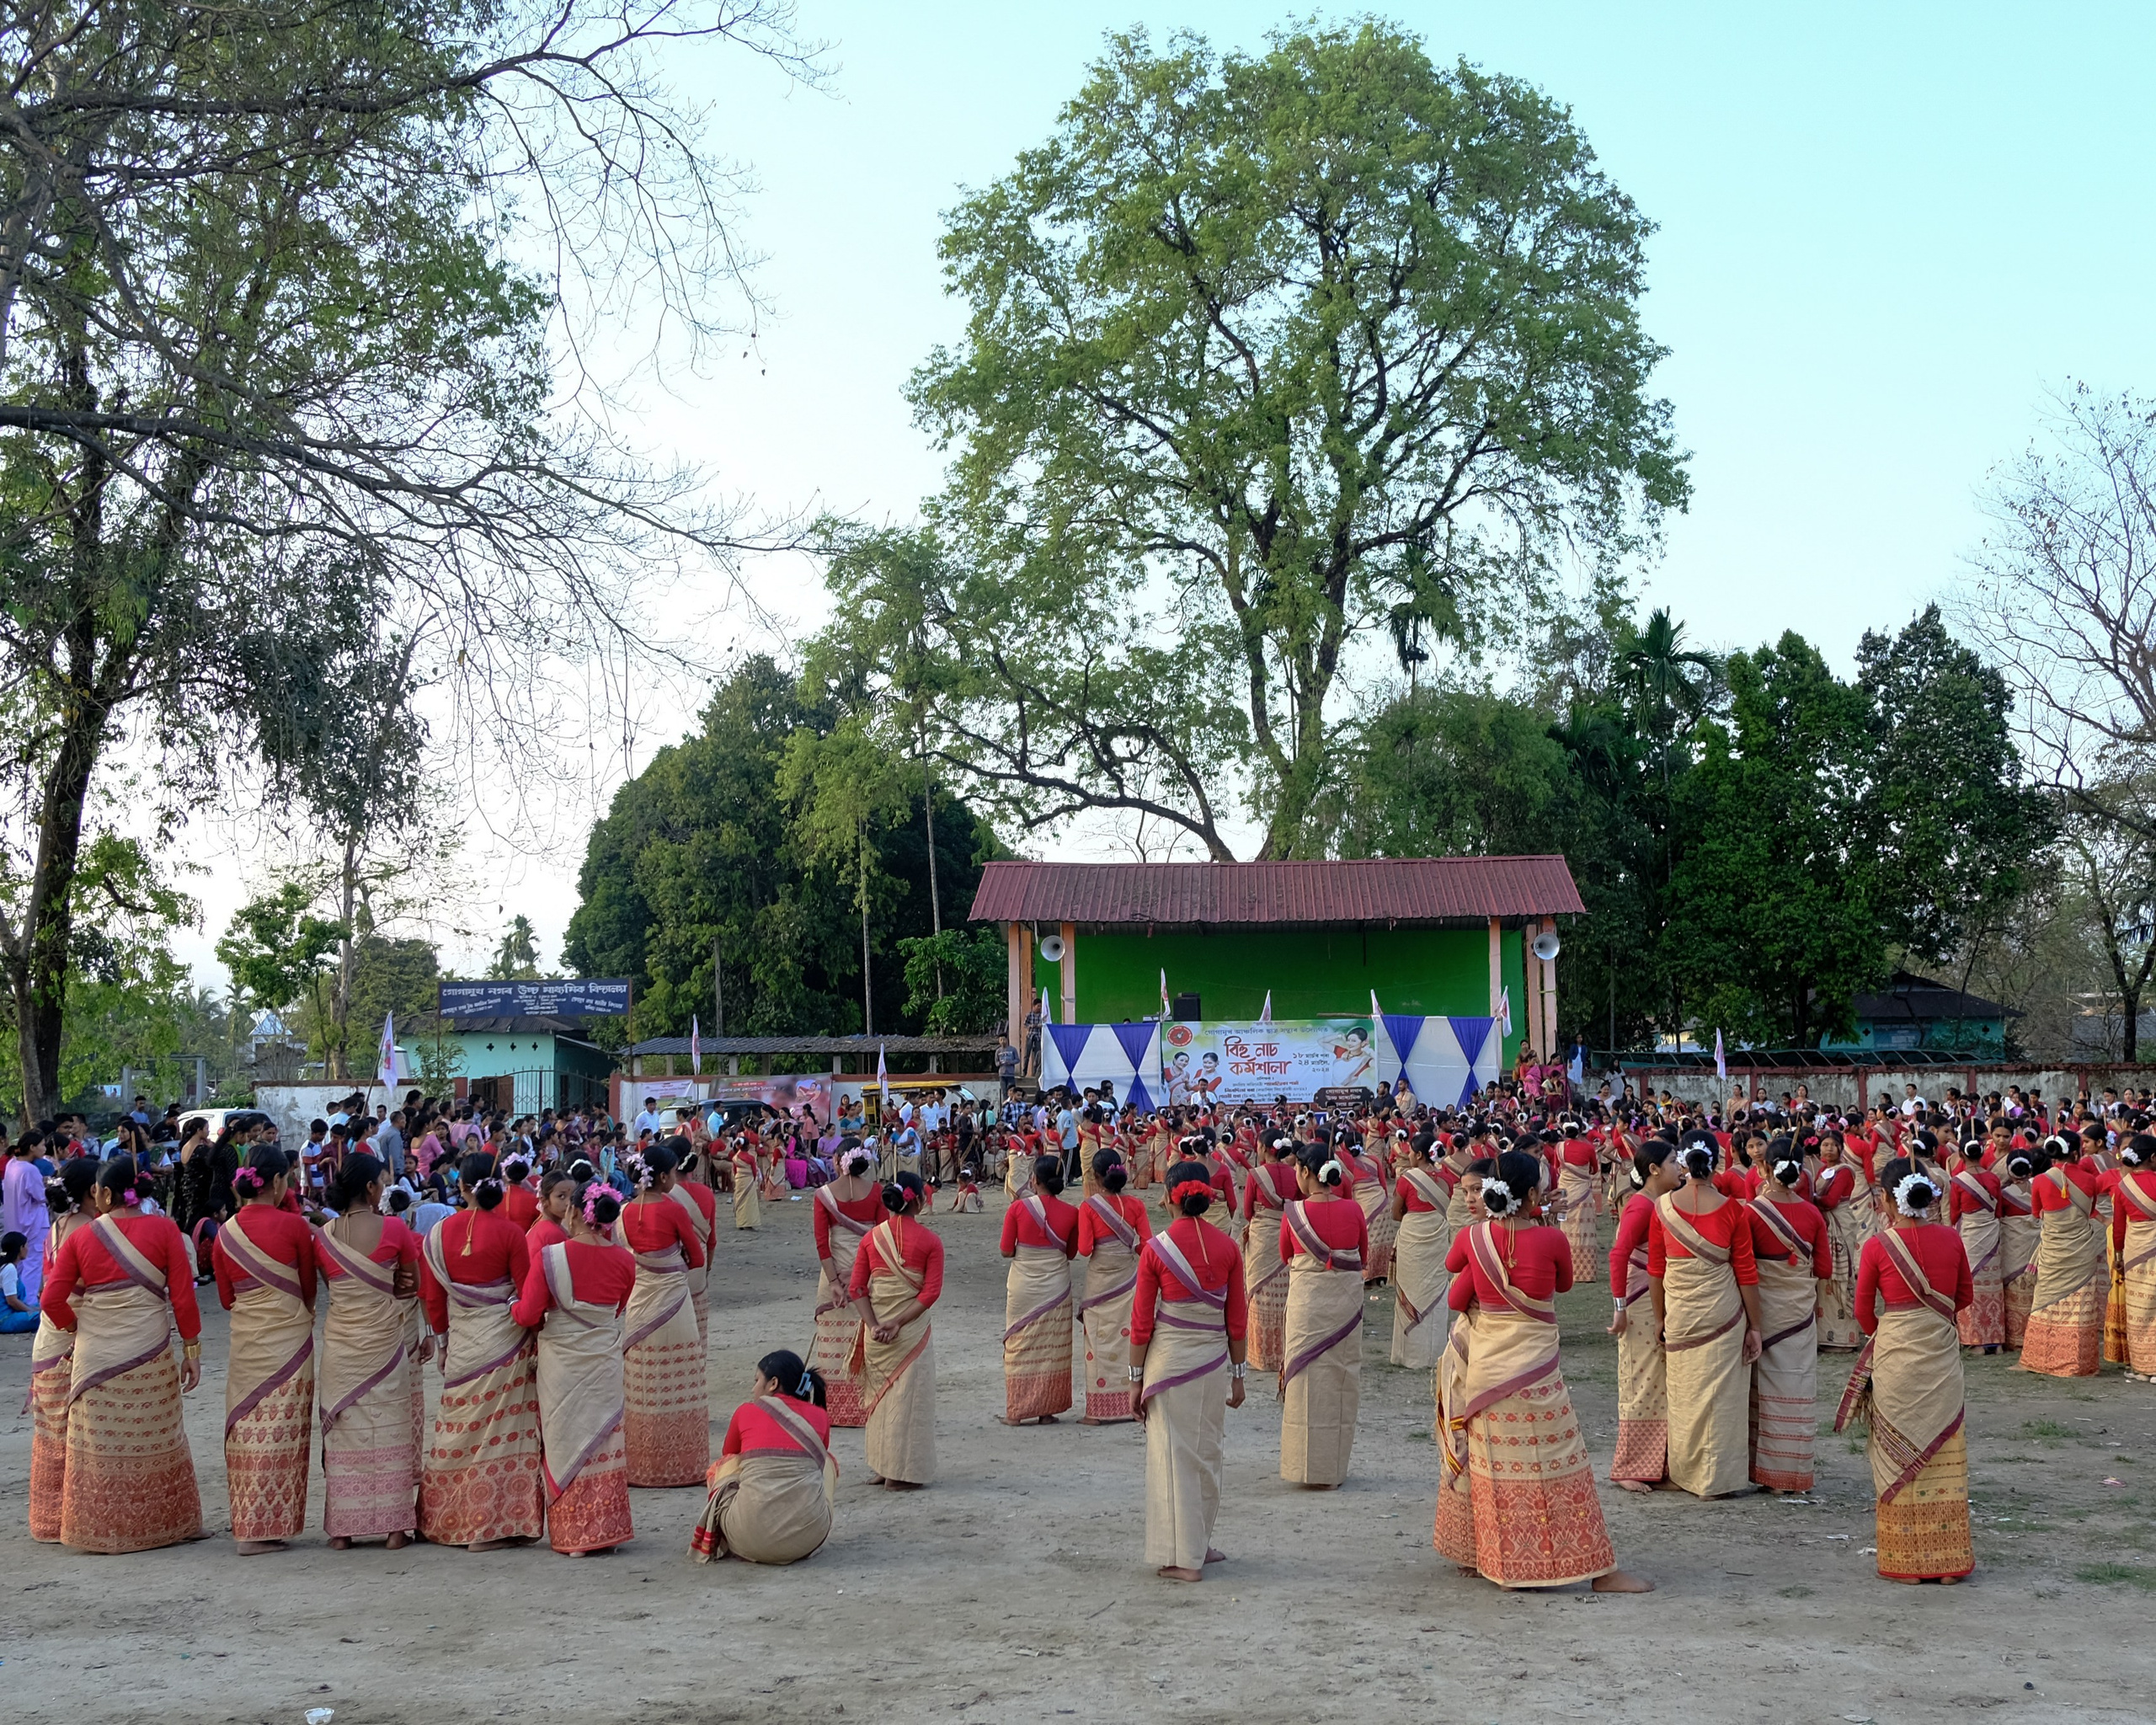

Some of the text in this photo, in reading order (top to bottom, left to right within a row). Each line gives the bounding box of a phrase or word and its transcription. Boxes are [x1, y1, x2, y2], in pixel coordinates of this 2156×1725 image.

[543, 983, 585, 995] মাধ্যমিক
[1223, 1035, 1280, 1059] বিহু নাচ
[1228, 1057, 1293, 1076] কৰ্মশালা
